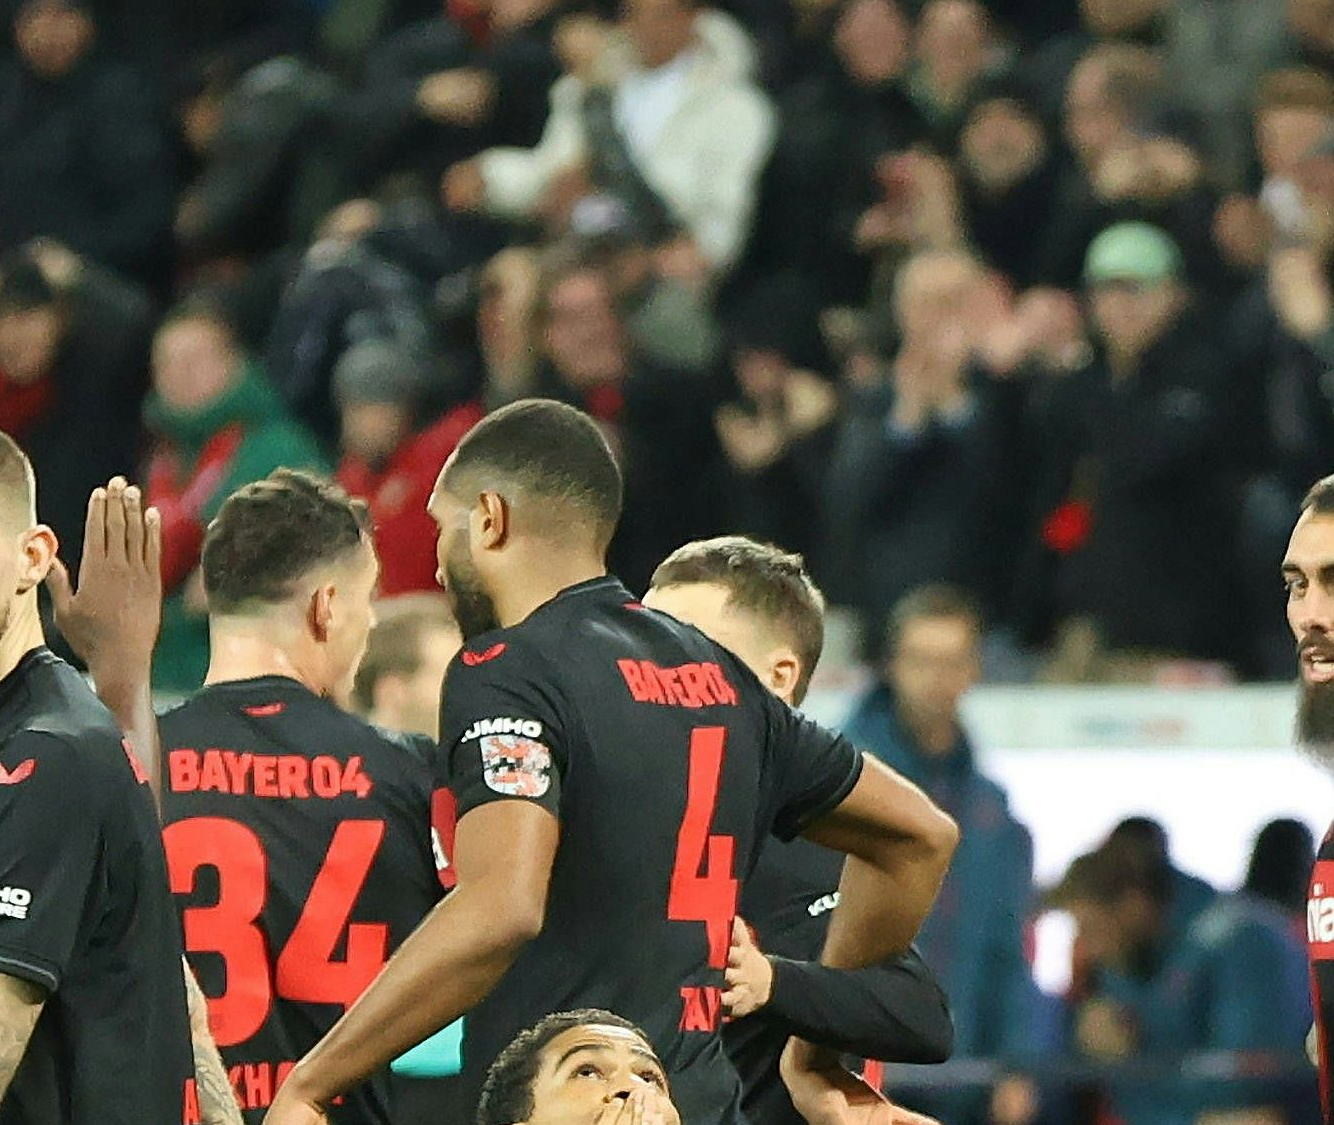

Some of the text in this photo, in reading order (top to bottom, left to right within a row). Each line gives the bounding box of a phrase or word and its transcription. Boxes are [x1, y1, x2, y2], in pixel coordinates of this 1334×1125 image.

[169, 748, 373, 798] BAYER04
[461, 717, 542, 744] UMHO
[667, 726, 739, 970] 4
[161, 816, 385, 1048] 34
